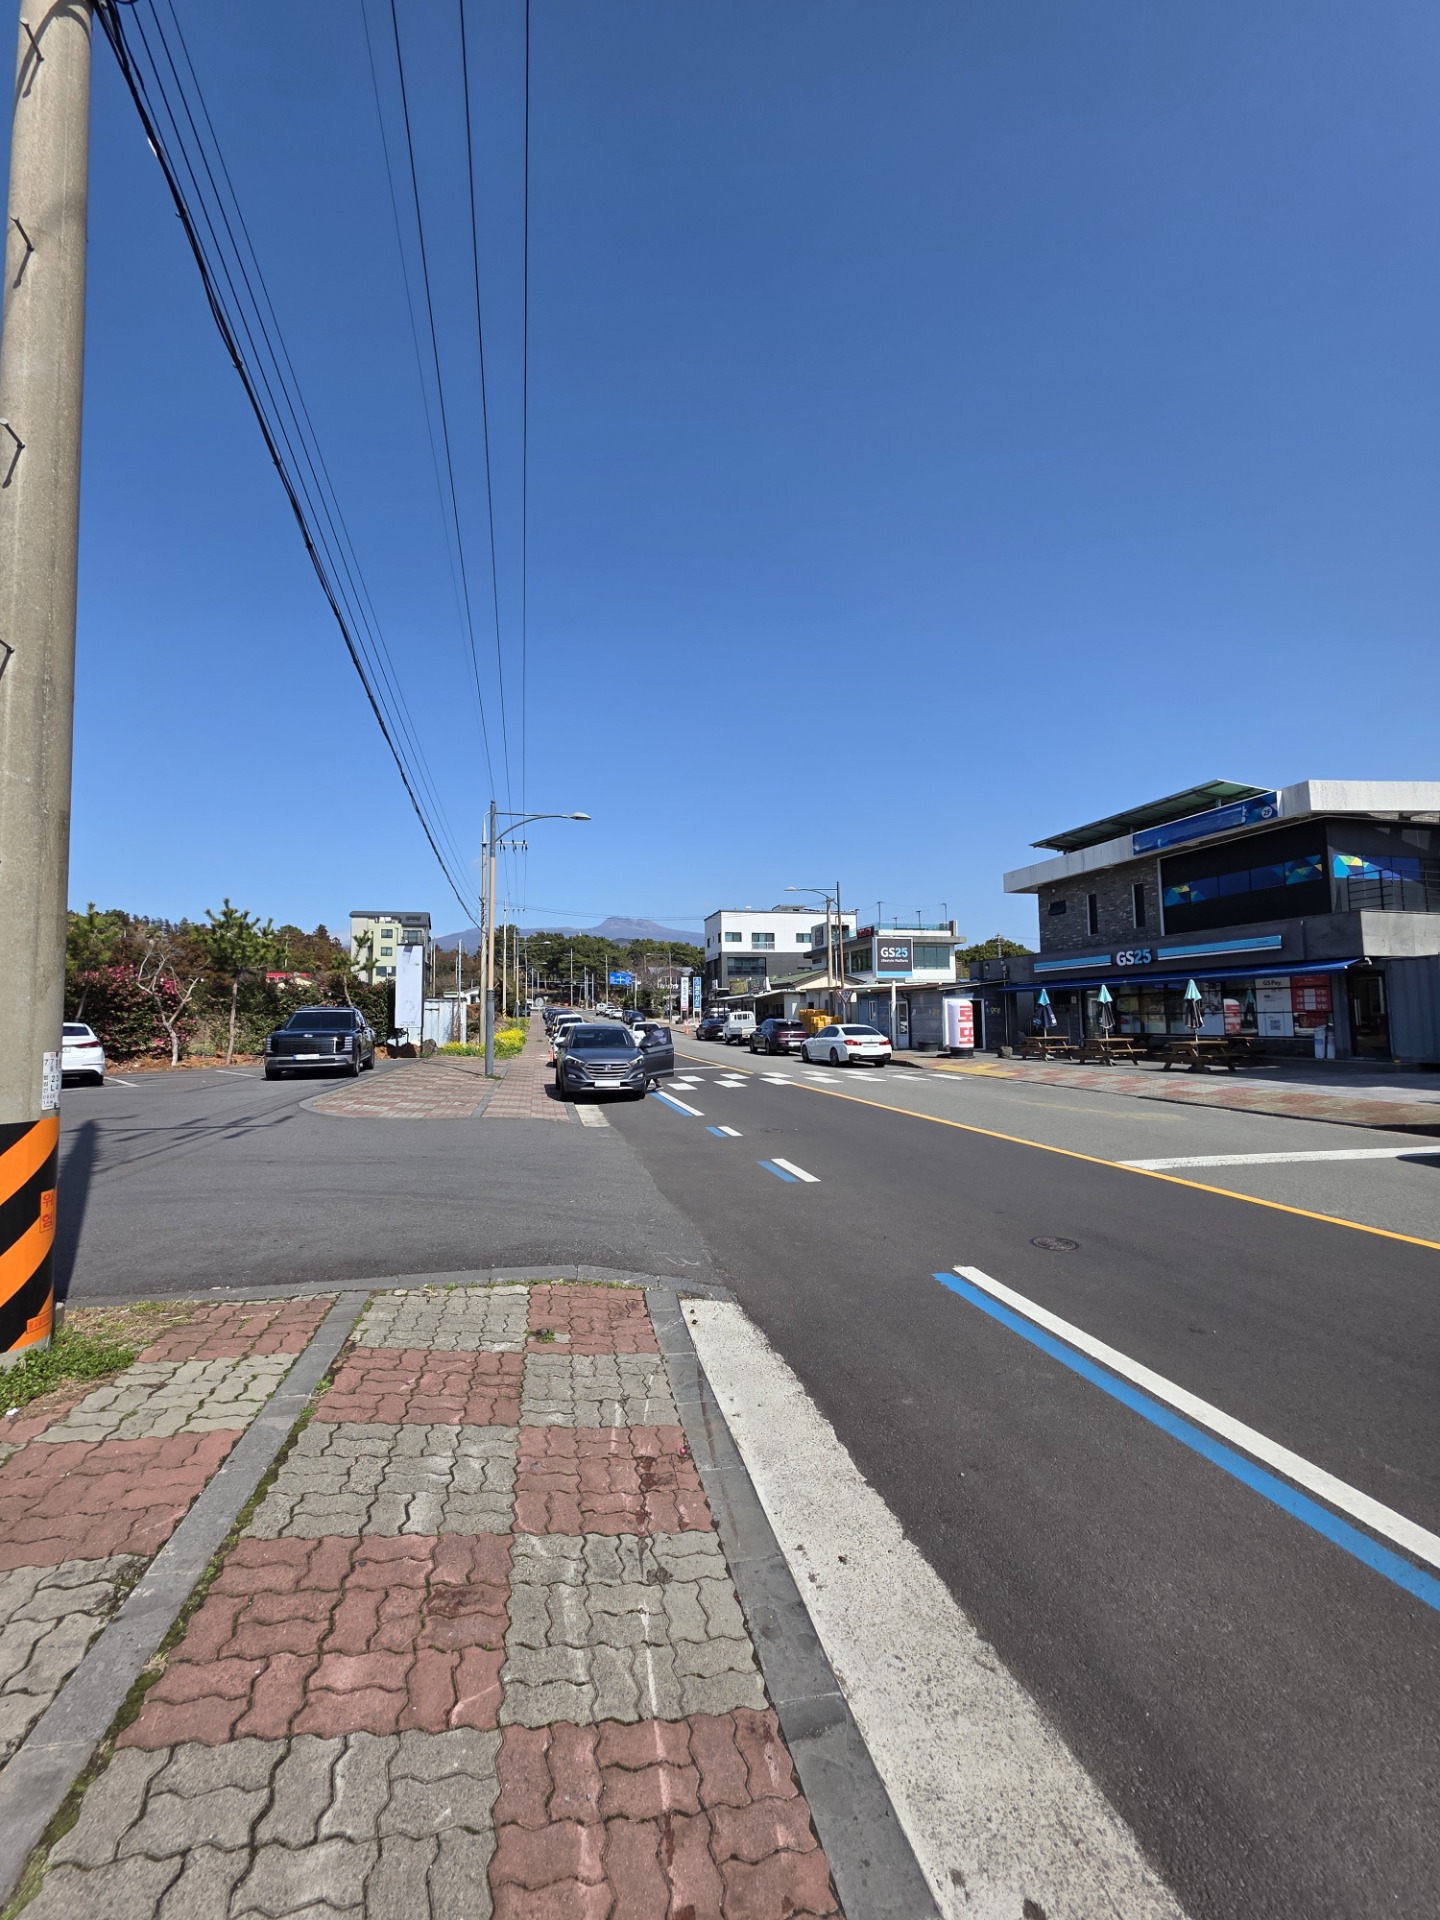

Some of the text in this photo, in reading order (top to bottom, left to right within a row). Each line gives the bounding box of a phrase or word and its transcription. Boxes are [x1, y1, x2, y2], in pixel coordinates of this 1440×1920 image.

[880, 946, 908, 958] GS25
[1116, 949, 1152, 966] GS25
[42, 1193, 52, 1228] 위험
